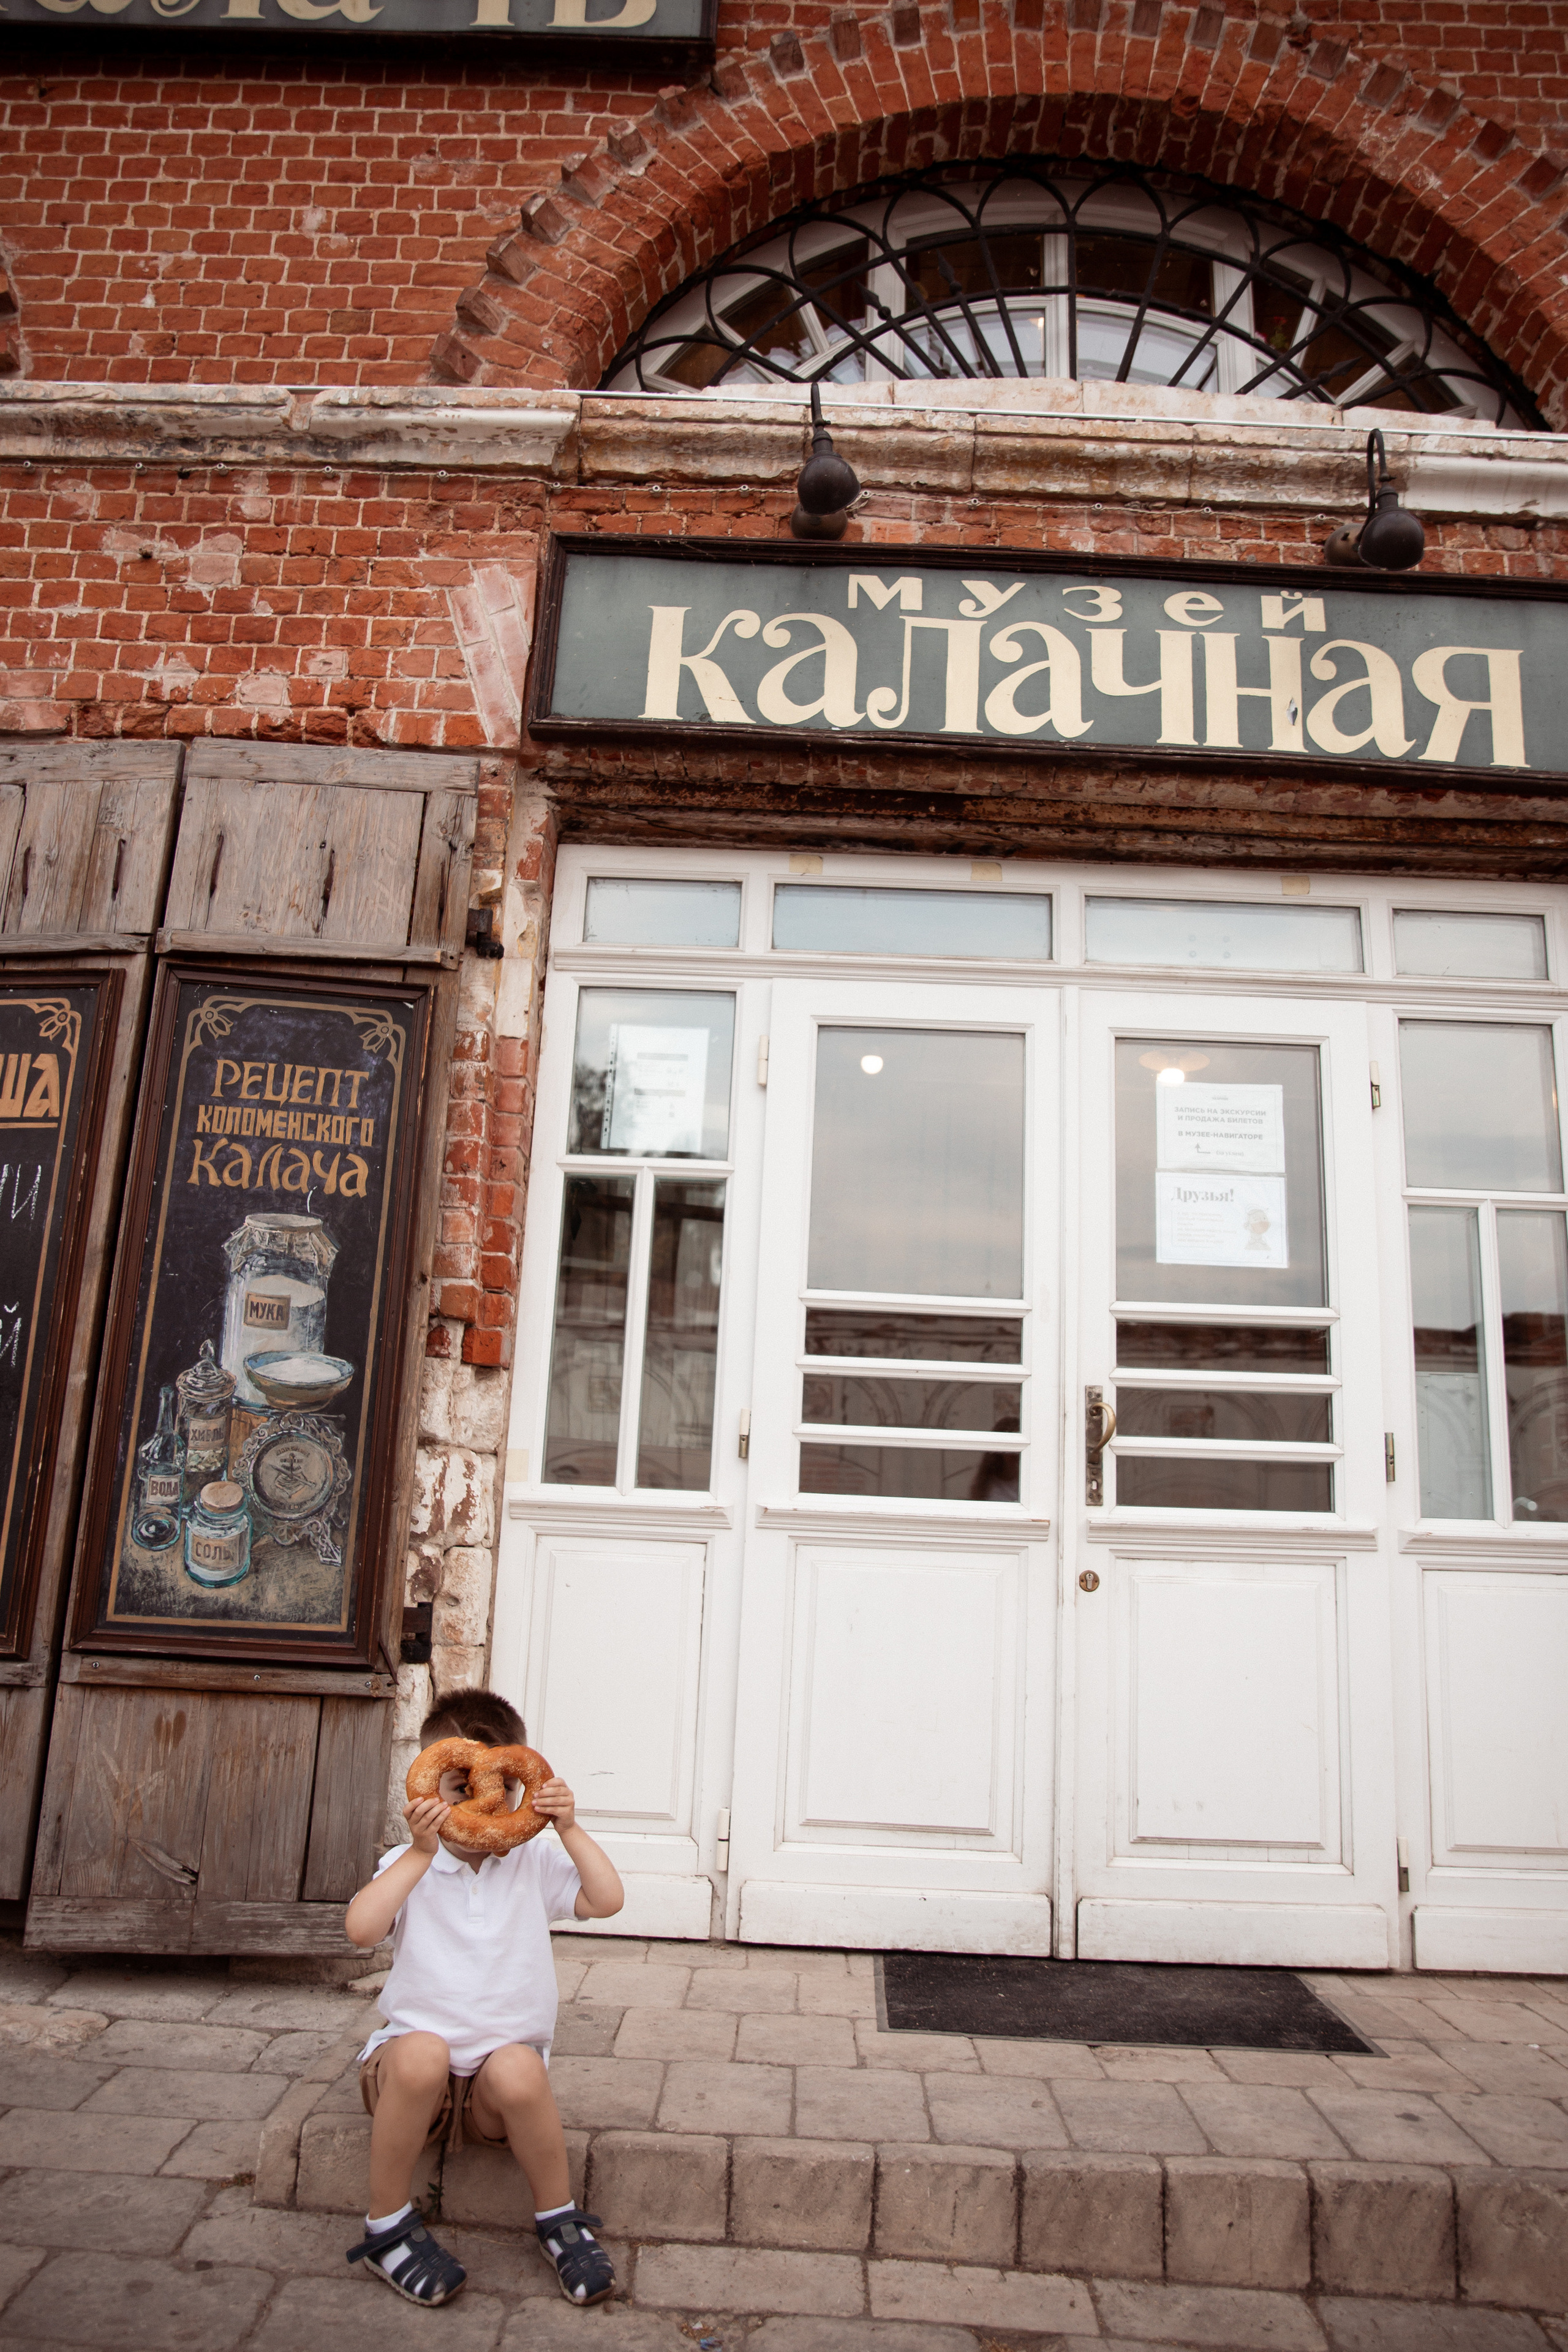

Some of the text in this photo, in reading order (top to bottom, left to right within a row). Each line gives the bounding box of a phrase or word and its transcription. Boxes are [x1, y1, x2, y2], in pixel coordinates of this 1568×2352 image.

[211, 1059, 369, 1109] РЕЦЕПТ
[196, 1104, 374, 1147] КОЛОМЕНСКОГО
[1185, 1131, 1264, 1140] МУЗЕЕ-НАВИГАТОРЕ
[1170, 1186, 1235, 1203] Друзья!
[249, 1300, 285, 1321] МУКА
[190, 1427, 224, 1442] ХМЕЛЬ
[150, 1479, 179, 1496] ВОДА
[195, 1541, 232, 1561] СОЛЬ
